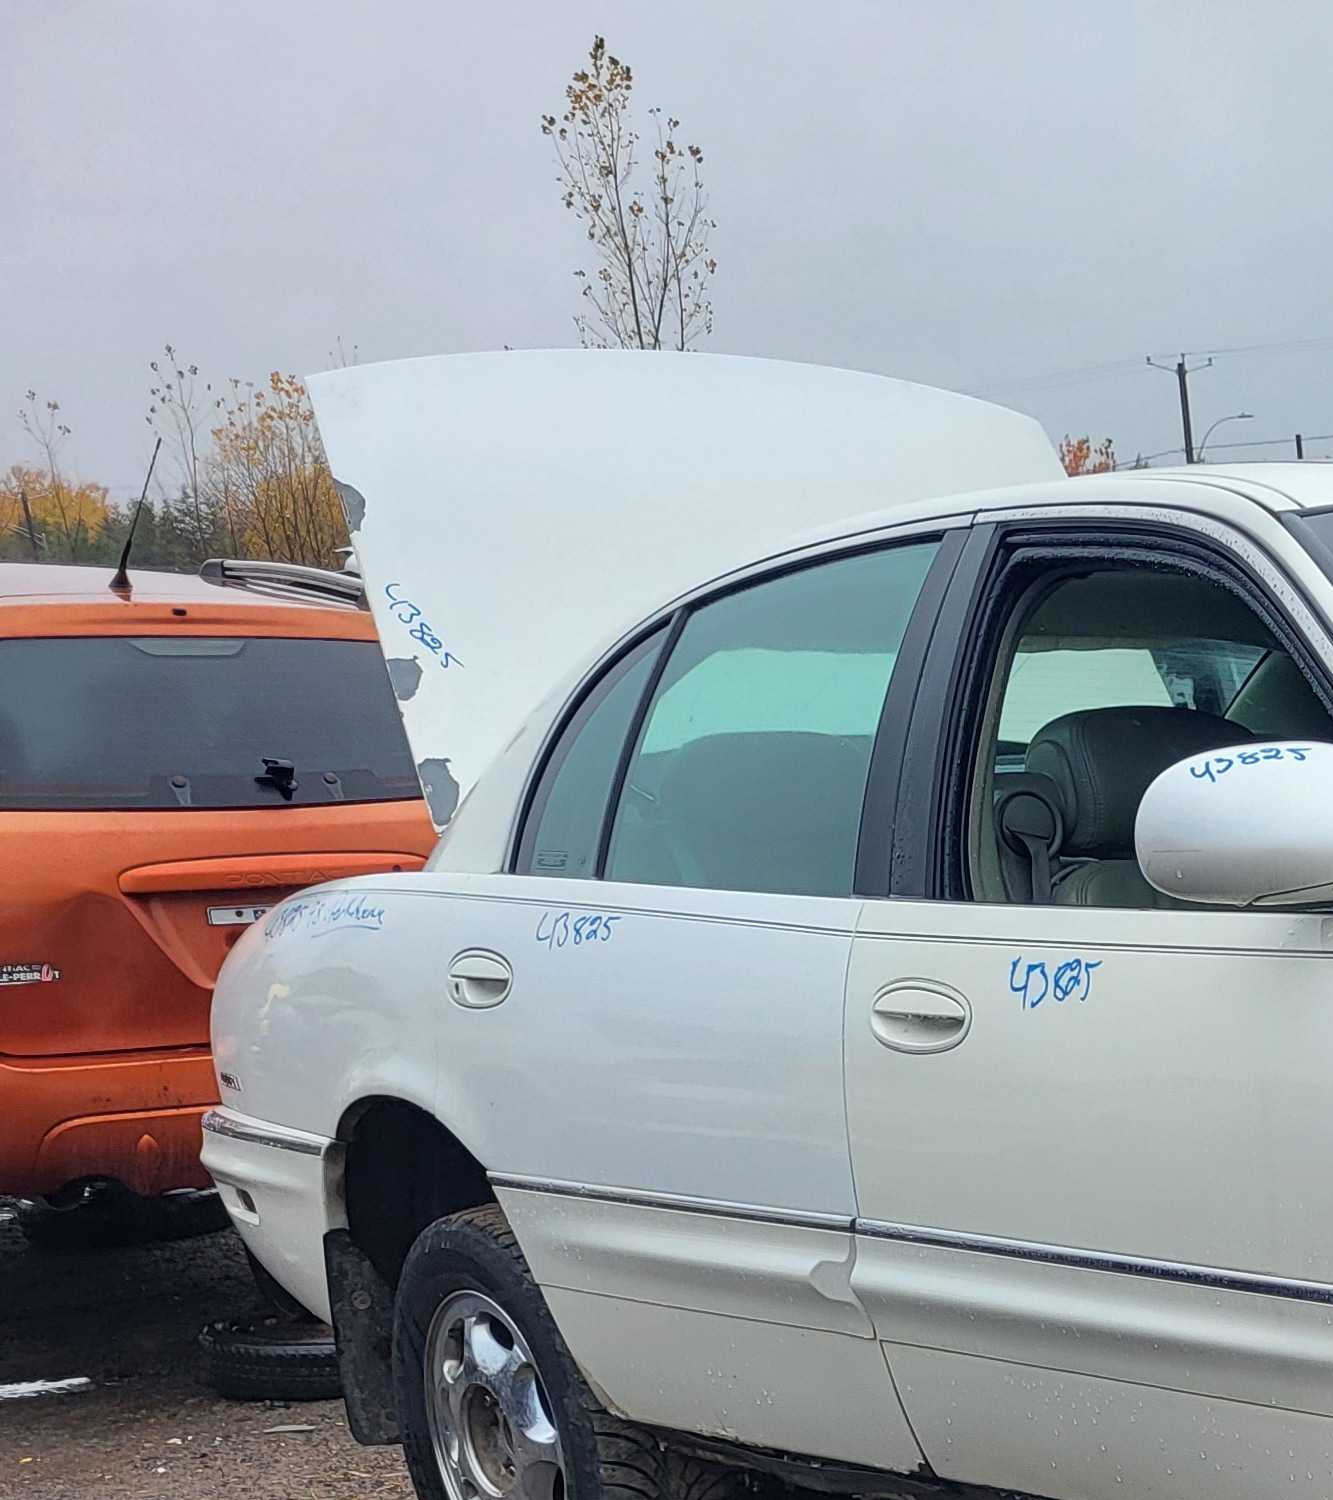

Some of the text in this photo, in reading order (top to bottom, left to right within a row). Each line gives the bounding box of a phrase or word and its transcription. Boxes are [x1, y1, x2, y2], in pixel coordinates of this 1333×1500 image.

[385, 583, 465, 669] 43825
[1190, 747, 1313, 783] 43825
[535, 911, 622, 952] 43825
[0, 963, 60, 982] E-PERROT
